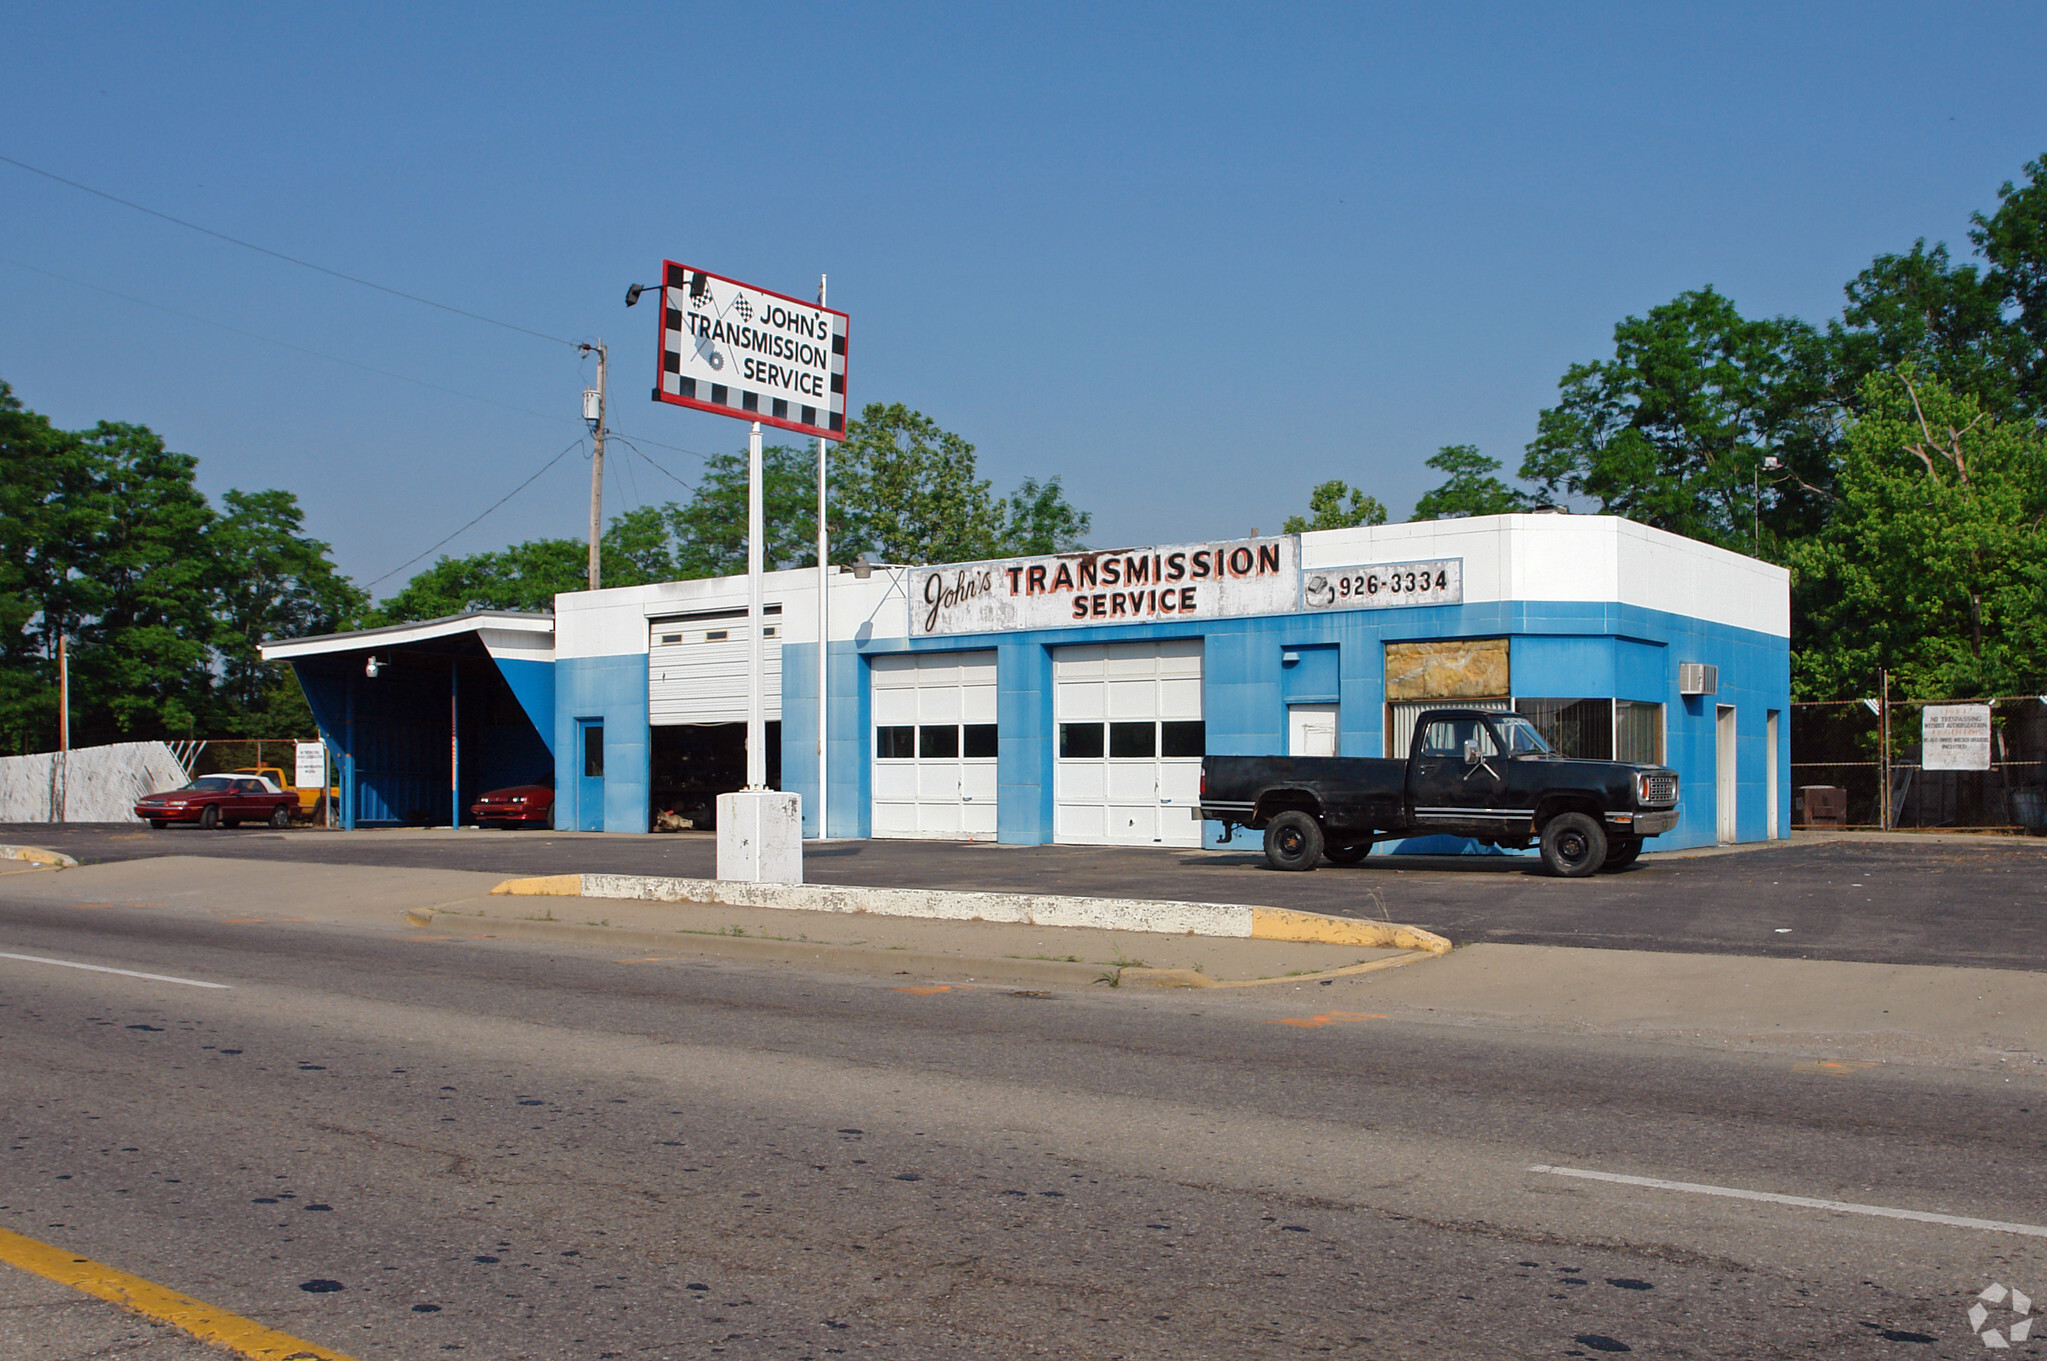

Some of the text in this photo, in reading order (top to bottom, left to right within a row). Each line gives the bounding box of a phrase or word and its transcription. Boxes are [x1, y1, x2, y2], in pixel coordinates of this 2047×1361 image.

[687, 311, 827, 370] TRANSMISSION
[760, 304, 827, 341] JOHN'S
[744, 358, 823, 398] SERVICE
[924, 544, 1280, 632] John's TRANSMISSION
[1072, 586, 1197, 620] SERVICE
[1339, 570, 1447, 598] 926-3334
